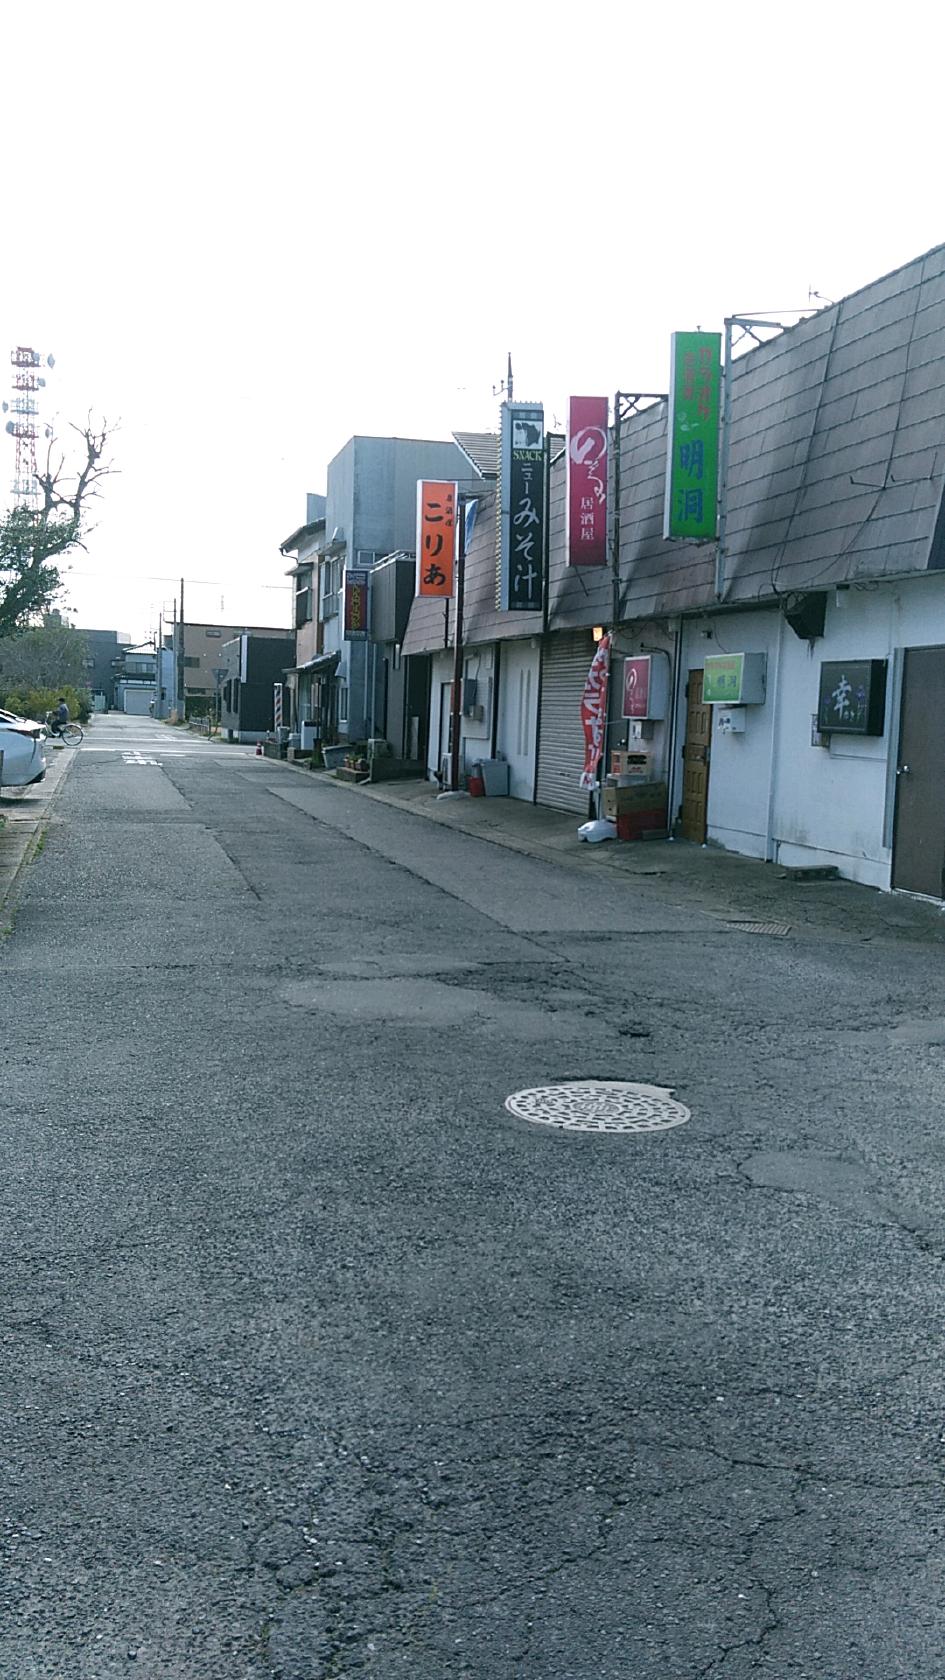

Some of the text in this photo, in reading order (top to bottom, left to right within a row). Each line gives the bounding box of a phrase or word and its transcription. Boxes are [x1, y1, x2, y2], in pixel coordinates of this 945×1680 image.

[513, 450, 542, 461] SNACK
[424, 503, 446, 586] こりあ
[513, 463, 540, 599] ニューみそ汁
[580, 497, 594, 541] 居酒屋
